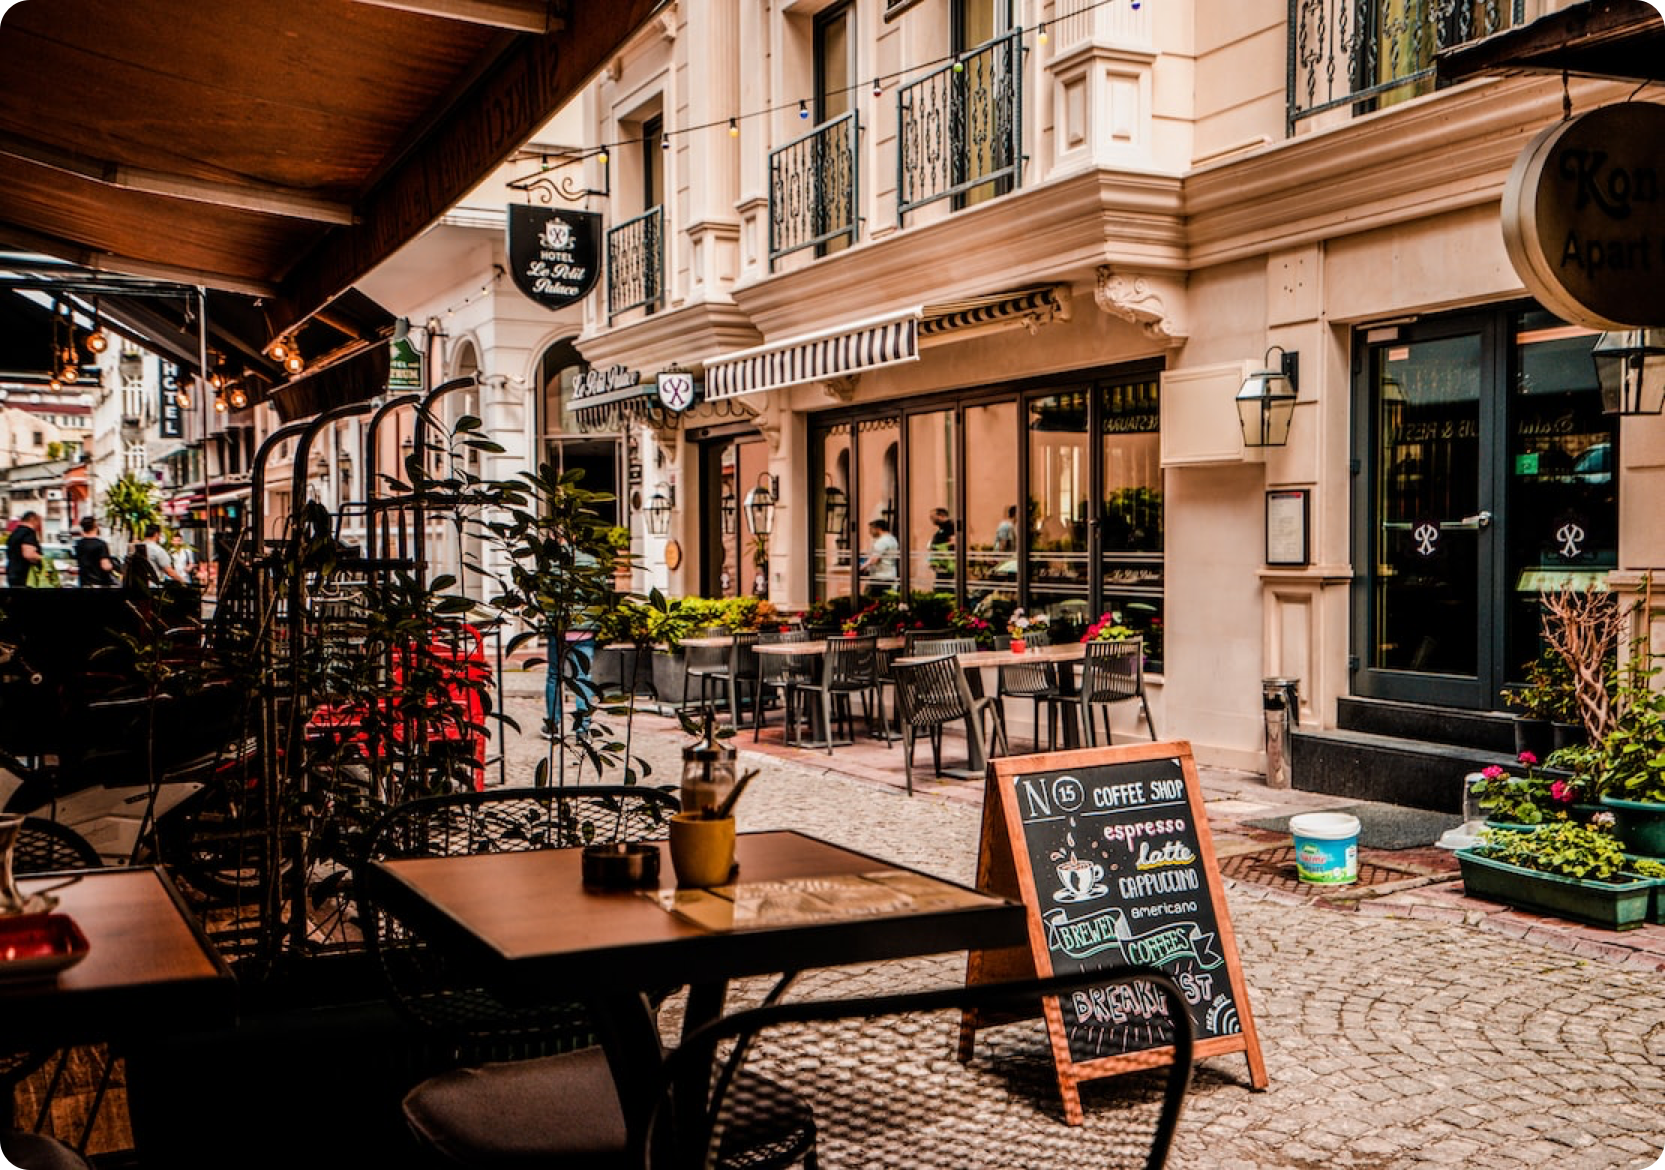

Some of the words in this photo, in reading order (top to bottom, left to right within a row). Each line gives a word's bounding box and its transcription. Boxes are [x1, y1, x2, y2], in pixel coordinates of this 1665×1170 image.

[540, 250, 575, 263] HOTEL
[1561, 229, 1650, 279] Apart
[526, 261, 550, 276] Le
[532, 278, 580, 296] Palace
[1058, 785, 1076, 802] 15
[1093, 782, 1146, 807] COFFEE
[1150, 779, 1184, 801] SHOP
[1103, 818, 1186, 853] espresso
[1118, 868, 1200, 899] CAPPUCCINO
[1130, 901, 1198, 919] americano
[1060, 915, 1117, 950] BREWED
[1127, 928, 1189, 965] COFFEES
